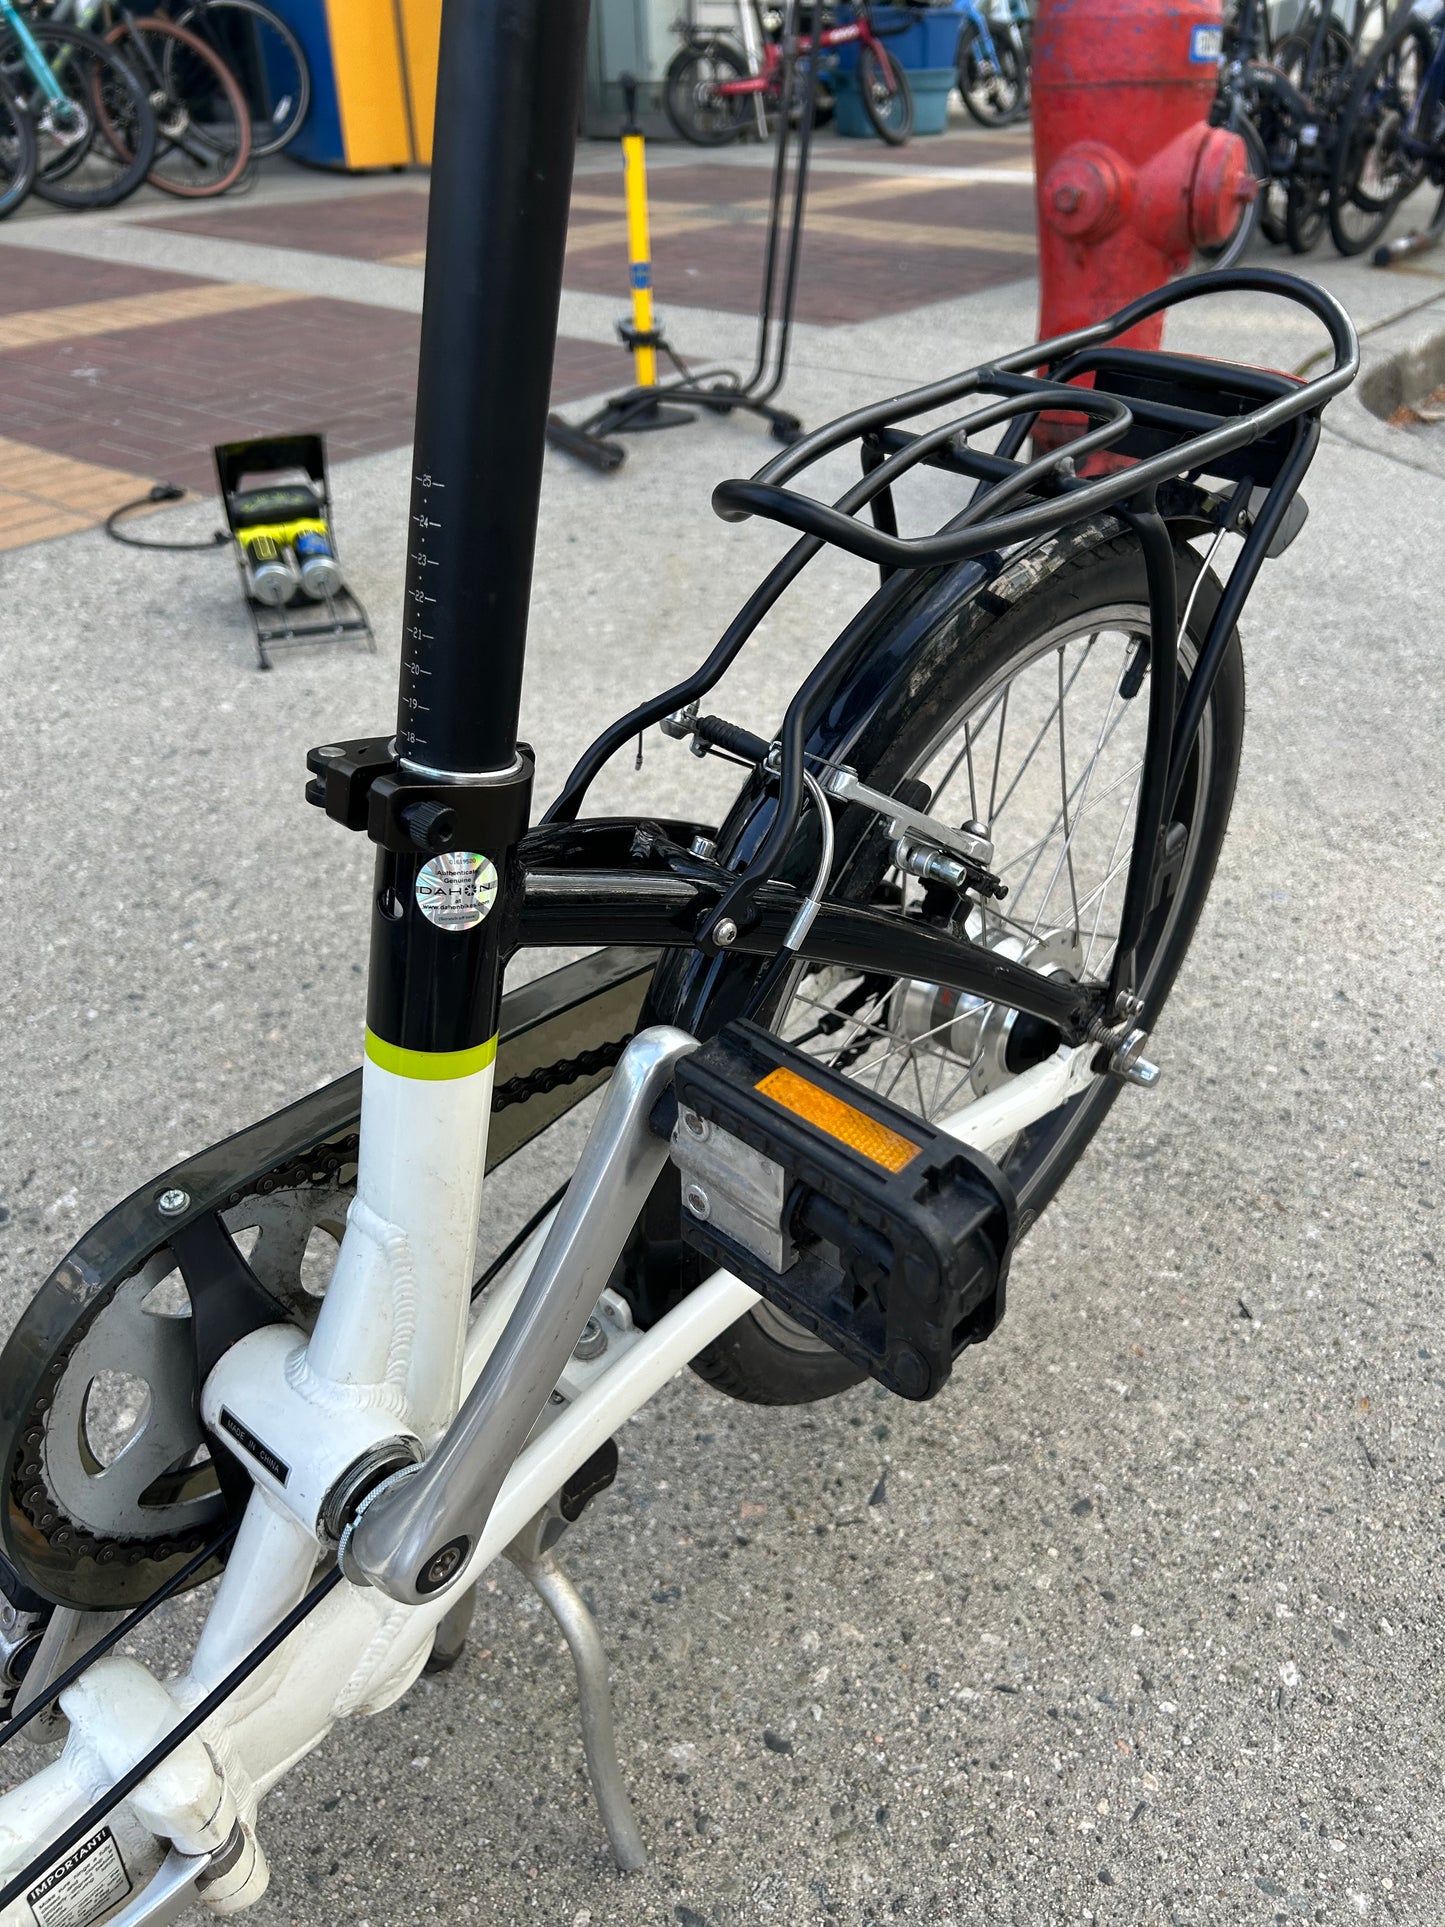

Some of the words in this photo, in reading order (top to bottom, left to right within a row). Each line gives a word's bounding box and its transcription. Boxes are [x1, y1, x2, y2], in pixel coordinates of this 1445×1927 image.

[419, 882, 491, 896] DAHON
[422, 900, 490, 910] www.dahonbikes.com
[227, 1419, 246, 1441] MADE
[248, 1439, 257, 1451] IN
[259, 1450, 281, 1474] CHINA
[31, 1830, 106, 1900] IMPORTANT!
